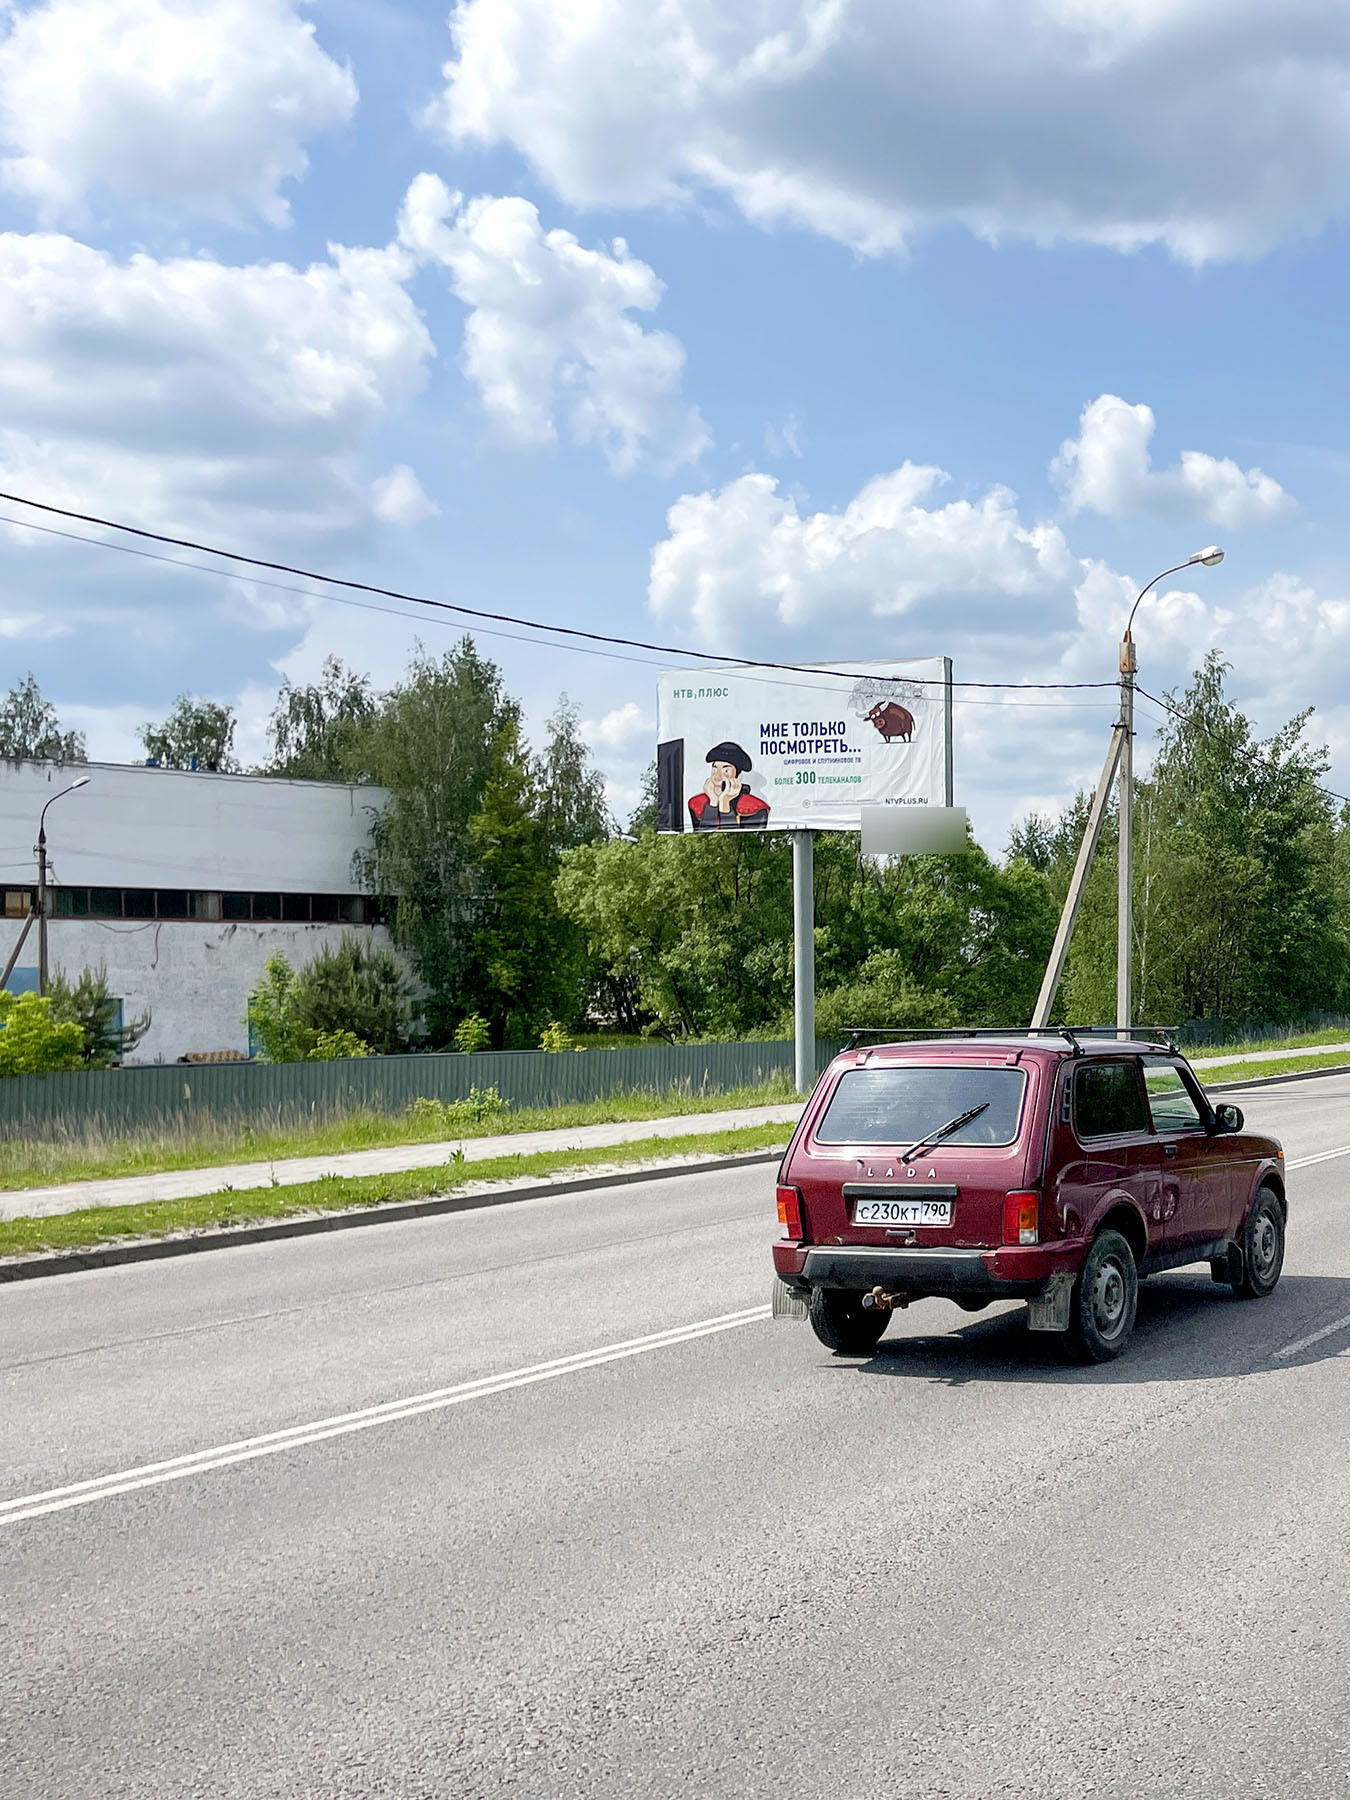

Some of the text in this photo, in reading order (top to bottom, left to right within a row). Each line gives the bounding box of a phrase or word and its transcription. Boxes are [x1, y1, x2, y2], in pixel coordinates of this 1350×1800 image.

[760, 721, 846, 738] МНЕ ТОЛЬКО
[760, 739, 861, 755] ПОСМОТРЕТЬ...
[774, 771, 862, 785] БОЛЕЕ 300 ТЕЛЕКАНАЛОВ
[867, 1168, 937, 1178] LADA
[860, 1203, 946, 1221] С230КТ 790
